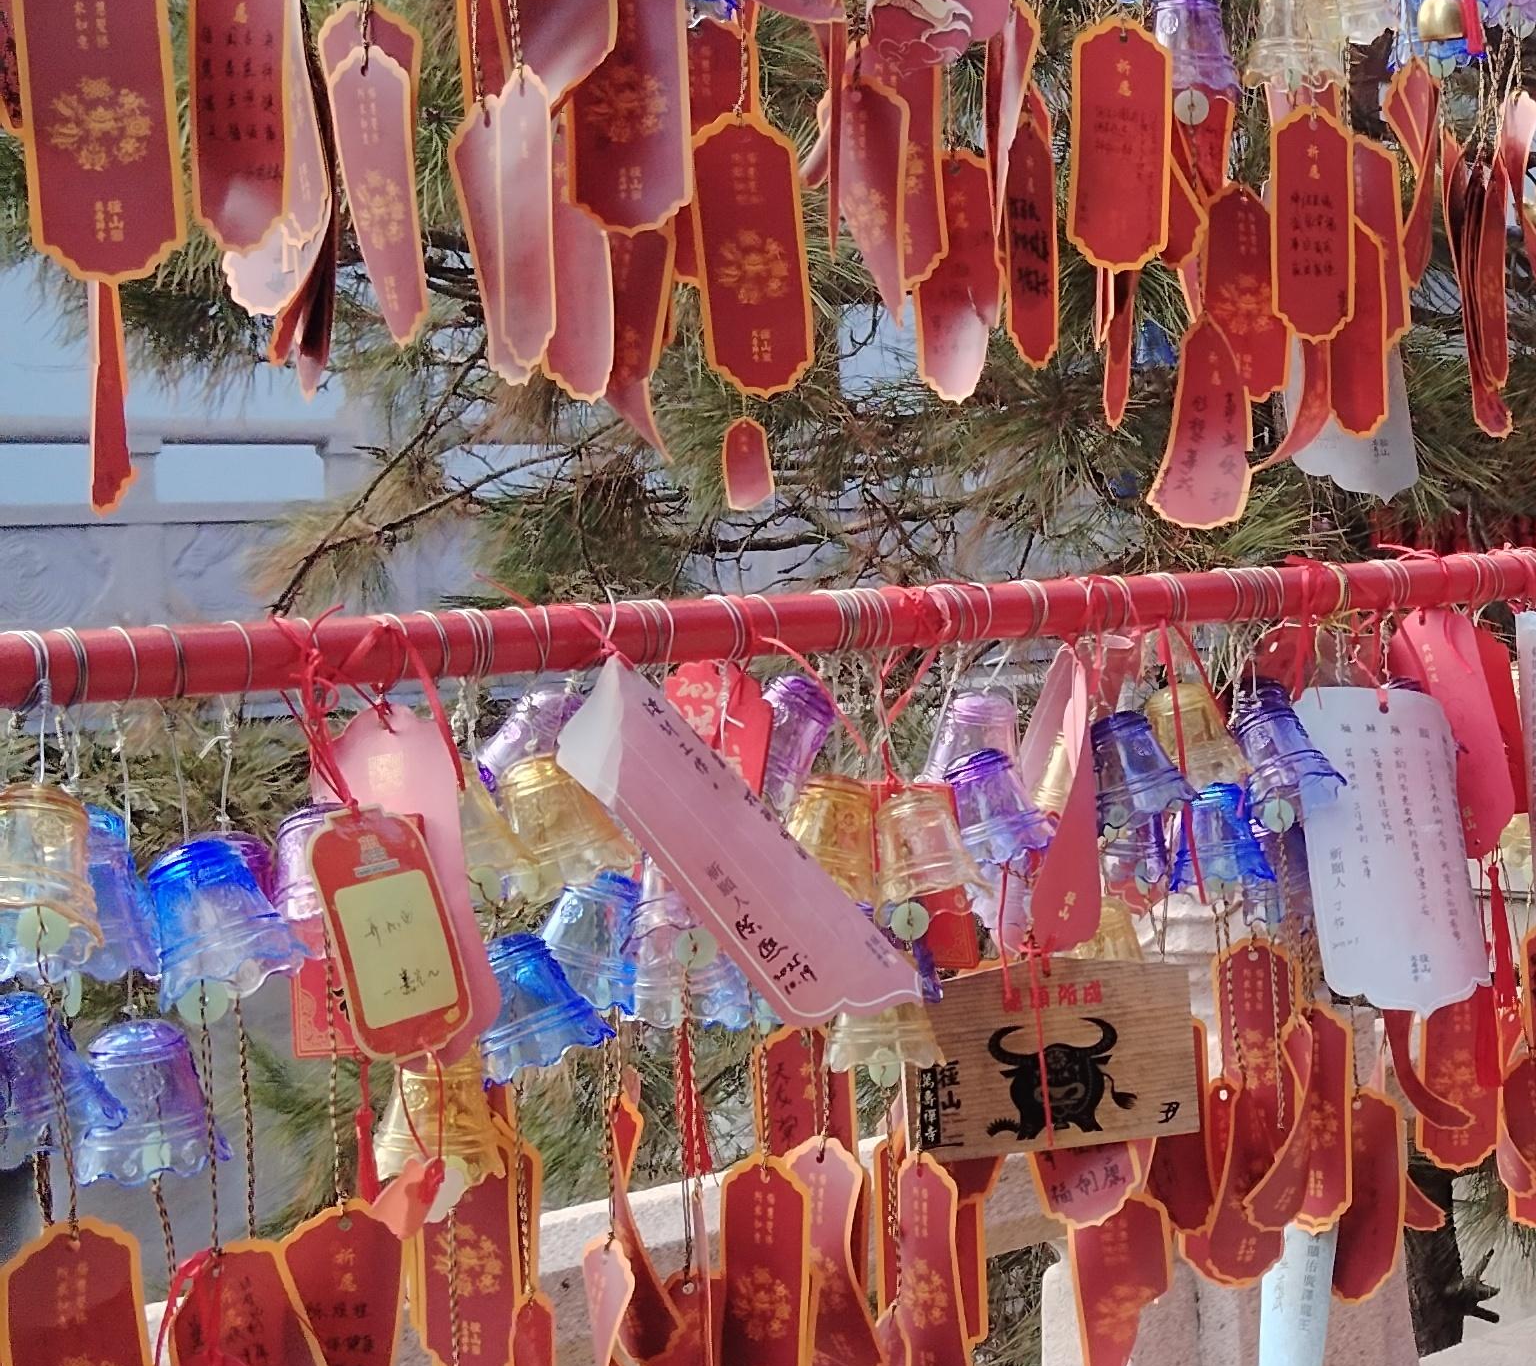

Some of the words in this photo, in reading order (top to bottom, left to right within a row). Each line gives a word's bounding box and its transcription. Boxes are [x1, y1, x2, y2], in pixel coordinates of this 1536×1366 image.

[920, 1070, 938, 1144] 萬壽禪寺
[938, 1060, 961, 1112] 徑山
